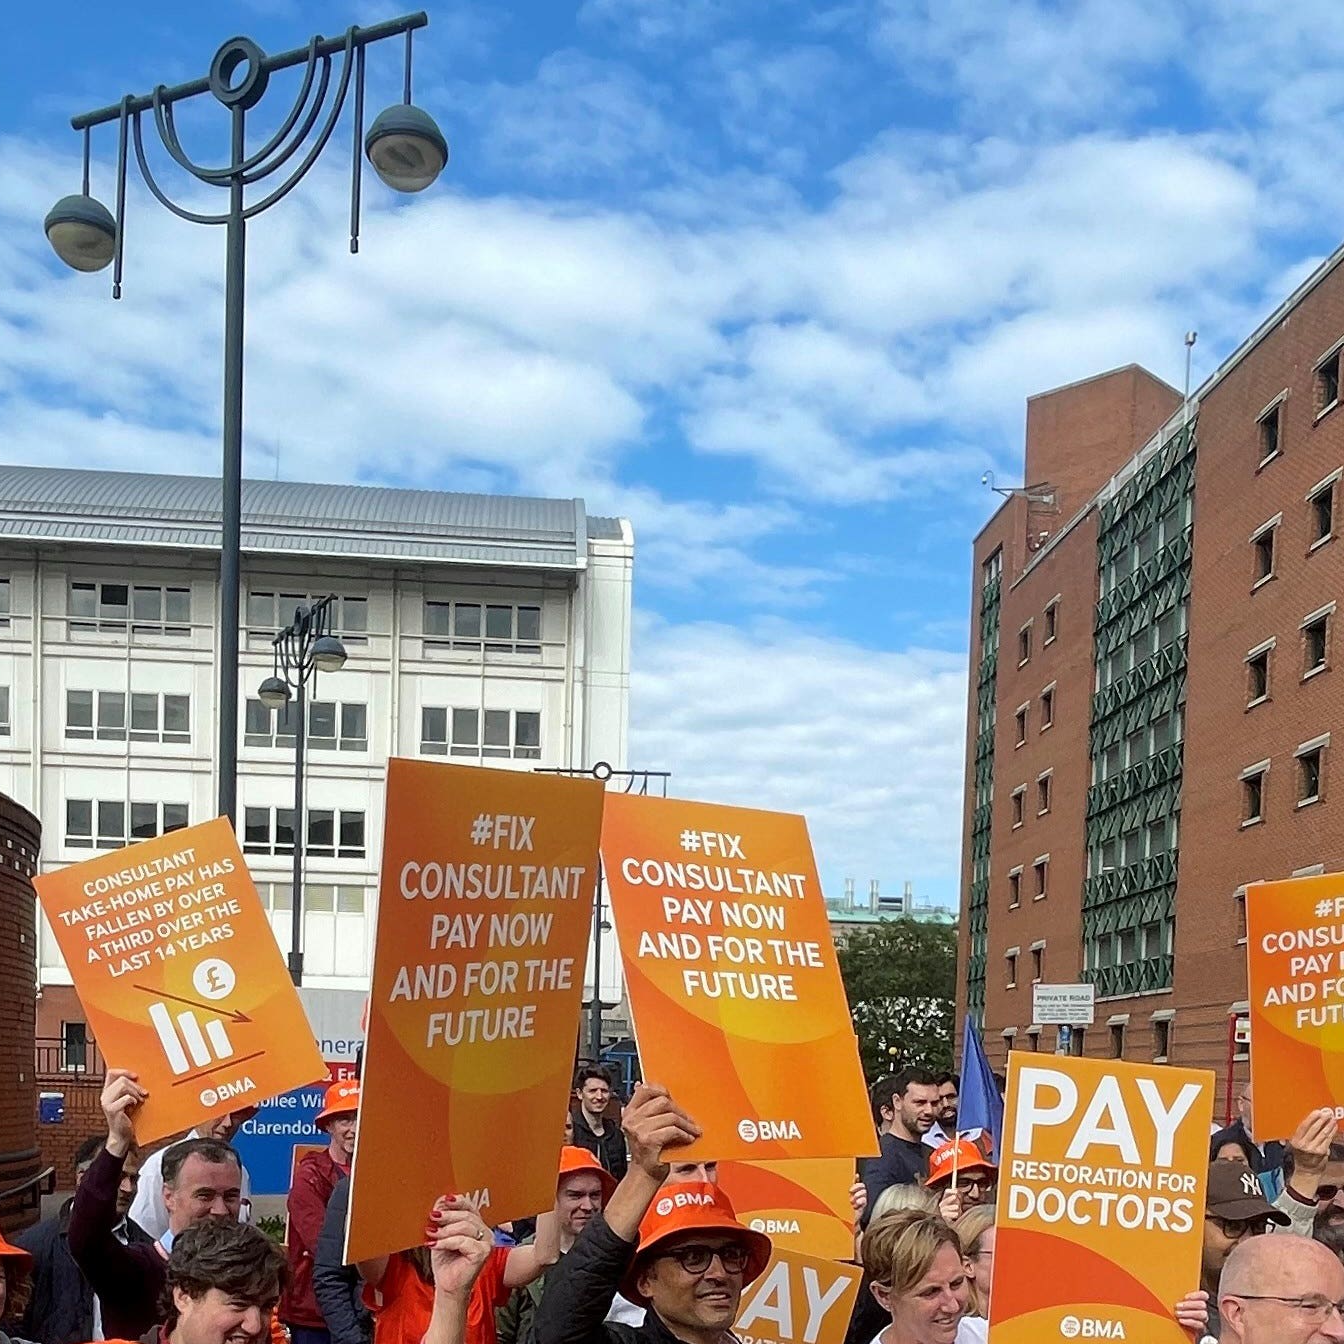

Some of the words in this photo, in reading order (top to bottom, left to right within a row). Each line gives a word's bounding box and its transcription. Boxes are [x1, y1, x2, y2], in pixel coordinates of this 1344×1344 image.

[470, 813, 535, 852] #FIX
[680, 829, 746, 861] #FIX
[83, 848, 196, 897] CONSULTANT
[400, 860, 585, 900] CONSULTANT
[622, 858, 806, 900] CONSULTANT
[59, 883, 164, 928] TAKE-HOME
[164, 872, 198, 896] PAY
[199, 858, 236, 883] HAS
[85, 908, 151, 941] FALLEN
[155, 899, 178, 919] BY
[179, 882, 227, 911] OVER
[86, 947, 102, 963] A
[101, 928, 154, 958] THIRD
[155, 913, 206, 940] OVER
[204, 899, 242, 926] THE
[430, 913, 485, 950] PAY
[488, 912, 553, 947] NOW
[663, 897, 715, 926] PAY
[721, 901, 785, 931] NOW
[108, 950, 152, 978] LAST
[155, 945, 177, 961] 14
[177, 923, 235, 955] YEARS
[637, 931, 702, 960] AND
[709, 934, 762, 965] FOR
[767, 939, 824, 968] THE
[1290, 952, 1335, 977] PAY
[389, 963, 457, 1002] AND
[463, 959, 520, 997] FOR
[523, 957, 574, 992] THE
[682, 969, 798, 1001] FUTURE
[1263, 982, 1316, 1008] AND
[426, 1005, 536, 1048] FUTURE
[217, 1075, 257, 1103] BMA
[757, 1120, 803, 1141] BMA
[1014, 1066, 1202, 1168] PAY
[1011, 1159, 1152, 1190] RESTORATION
[1156, 1171, 1196, 1195] FOR
[673, 1191, 715, 1209] BMA
[1008, 1185, 1194, 1234] DOCTORS
[766, 1219, 801, 1235] BMA
[735, 1261, 852, 1344] AY
[1081, 1318, 1126, 1341] BMA
